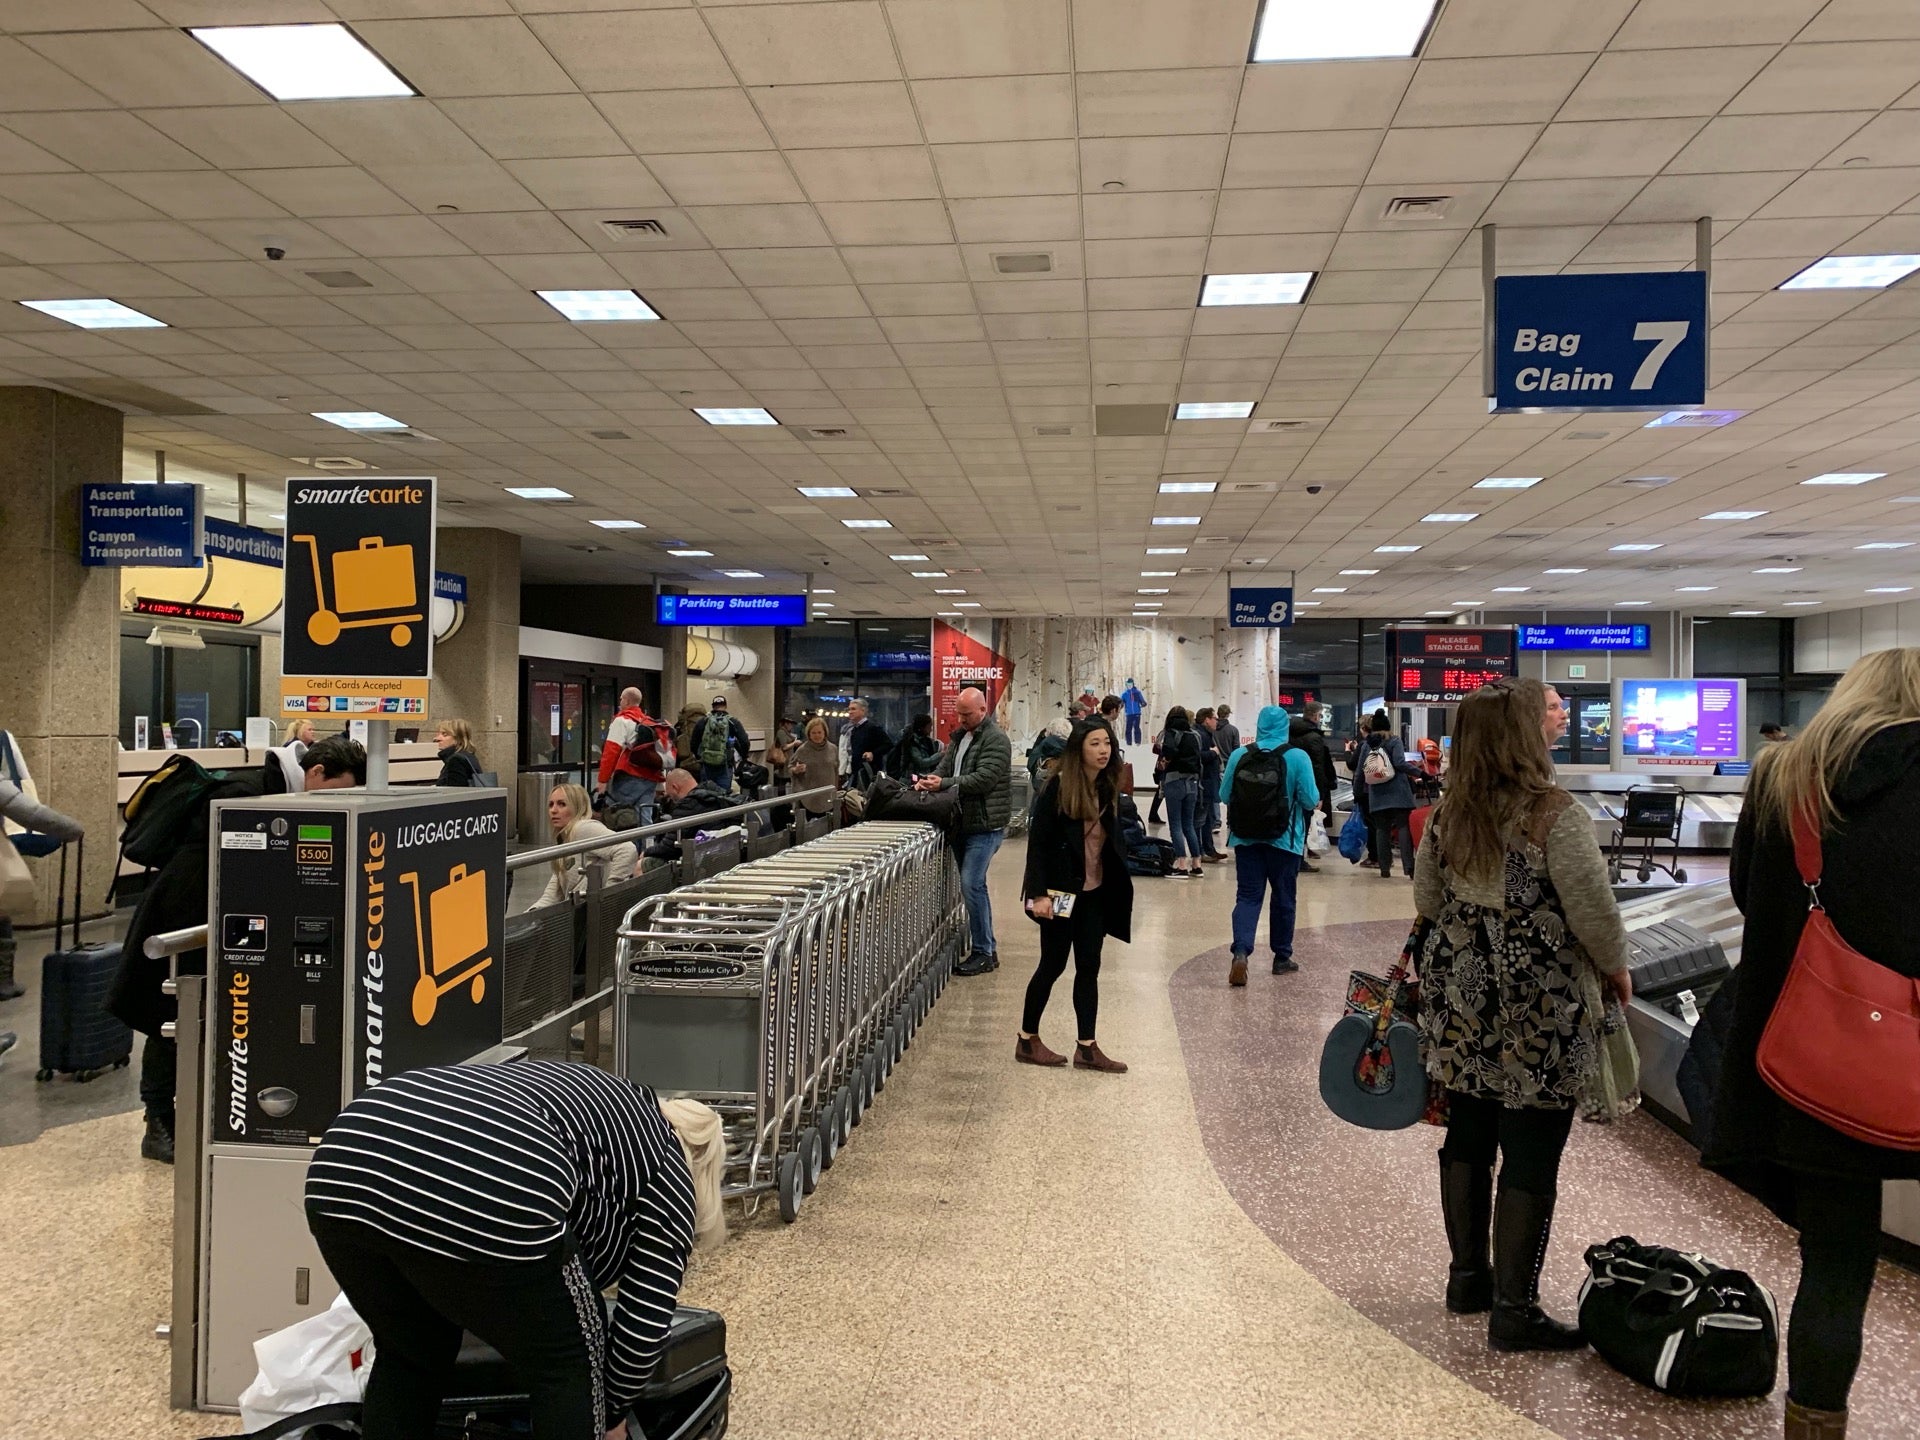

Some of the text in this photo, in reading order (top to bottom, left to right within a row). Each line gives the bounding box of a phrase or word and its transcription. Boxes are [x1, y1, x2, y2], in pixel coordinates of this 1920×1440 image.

[1514, 328, 1581, 357] Bag
[1630, 320, 1691, 391] 7
[1515, 367, 1614, 392] Claim
[89, 489, 135, 501] Ascent
[294, 485, 423, 504] smartecarte
[89, 505, 183, 519] Transportation
[88, 530, 136, 544] Canyon
[204, 530, 284, 561] ansportation
[88, 546, 183, 560] Transportation
[679, 598, 780, 609] Parking Shuttles
[1235, 603, 1256, 613] Bag
[1235, 615, 1266, 623] Claim
[1268, 601, 1288, 623] 8
[1526, 627, 1631, 635] Bus International
[1526, 636, 1631, 645] Plaza Arrivals
[942, 667, 1003, 679] EXPERIENCE
[307, 680, 402, 692] Credit Cards Accepted
[286, 699, 305, 708] VISA
[1416, 692, 1466, 702] Bag Cla
[396, 813, 499, 849] LUGGAGE CARTS
[300, 849, 328, 860] $5.00
[245, 954, 266, 962] CARDS
[362, 831, 386, 1087] martecarte
[674, 965, 682, 973] to
[682, 964, 697, 973] Salt
[698, 965, 715, 974] Lake
[717, 965, 731, 976] City
[788, 953, 801, 1078] smartecarte
[767, 967, 778, 1099] smartecarte
[228, 972, 250, 1136] smartecarte
